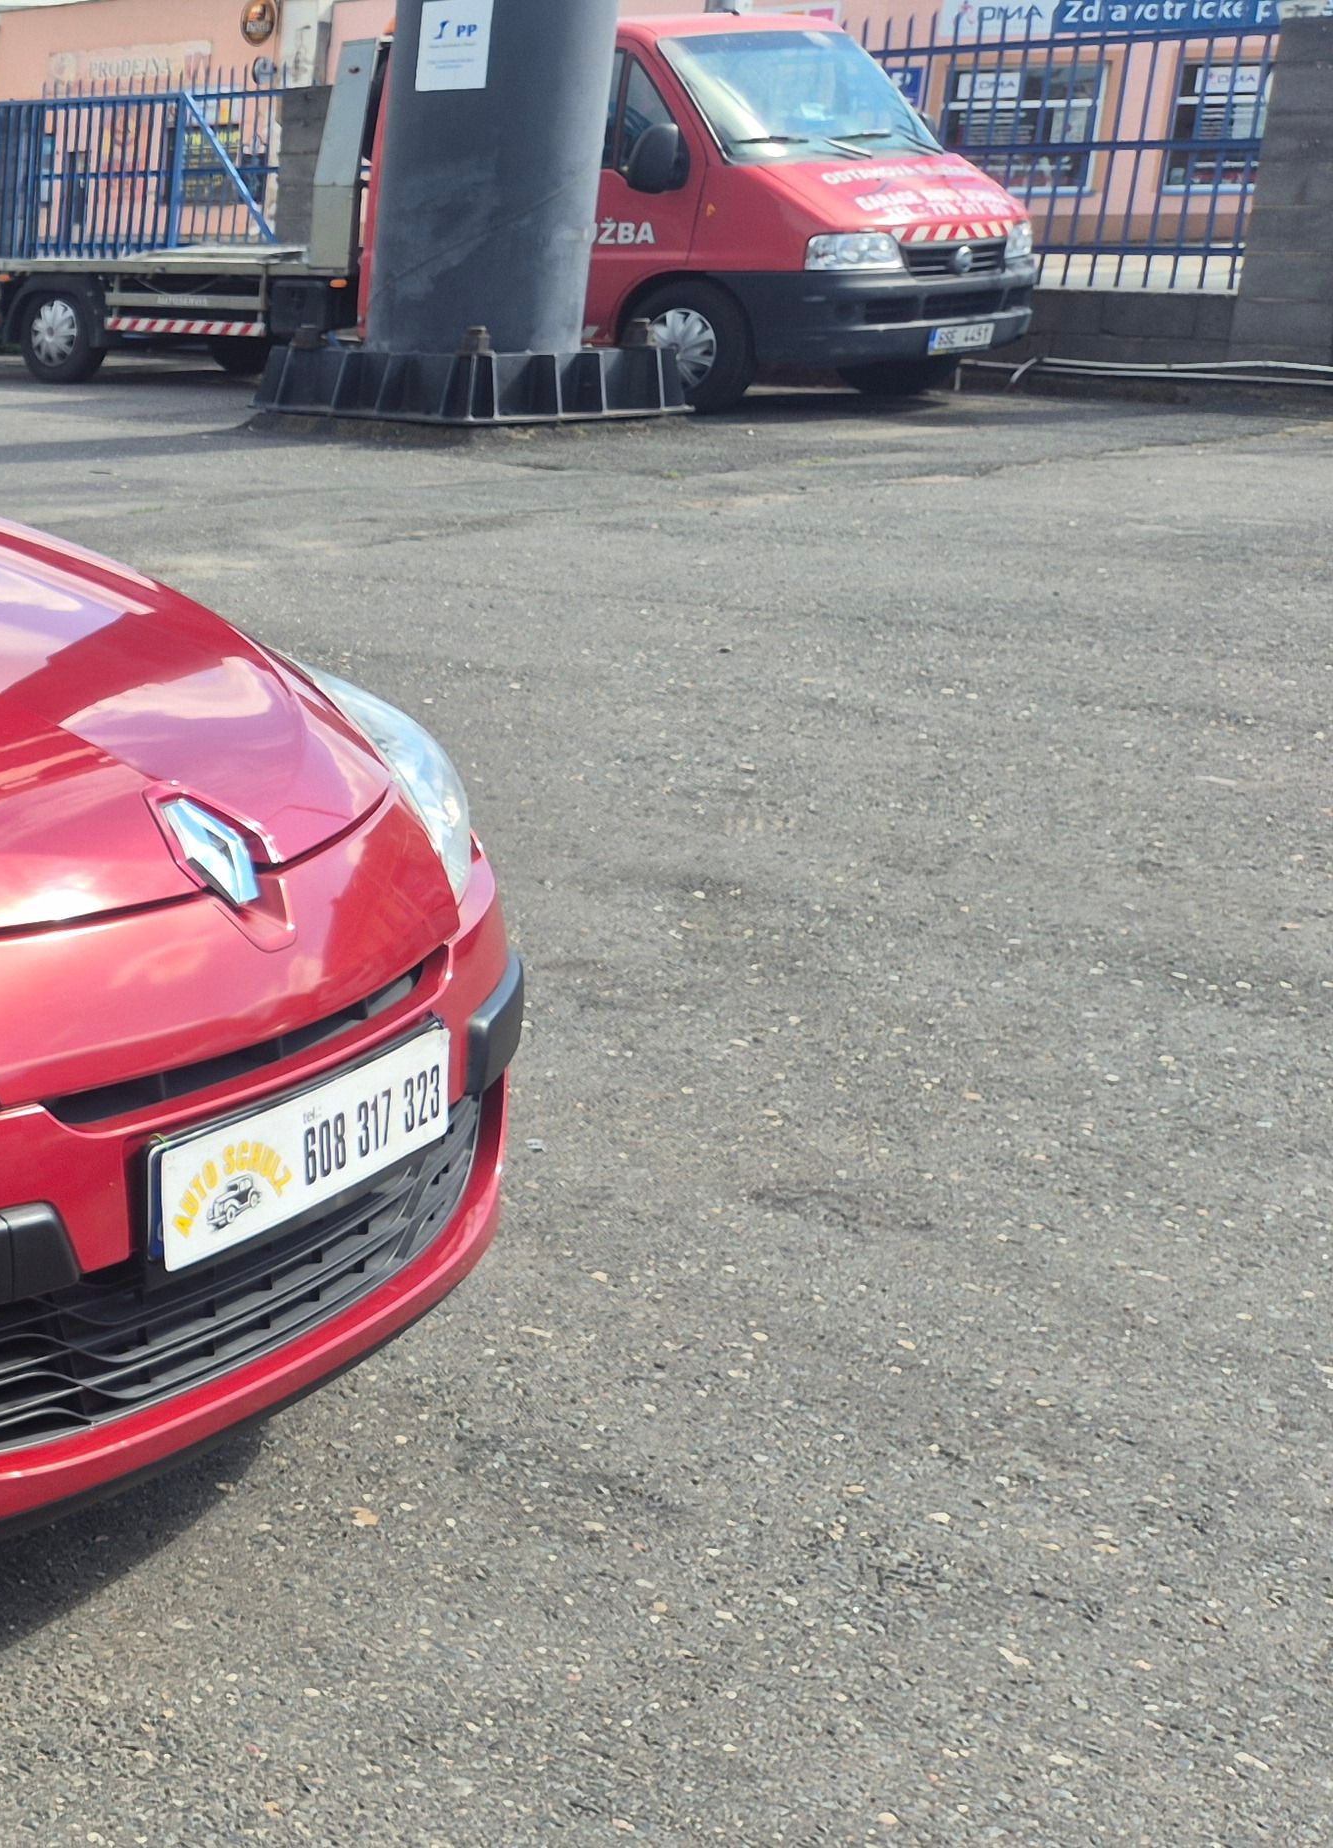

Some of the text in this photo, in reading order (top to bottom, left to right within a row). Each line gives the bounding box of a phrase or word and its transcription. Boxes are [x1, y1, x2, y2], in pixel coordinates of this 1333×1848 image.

[456, 24, 477, 37] PP
[593, 217, 656, 244] ŽBA
[304, 1064, 439, 1185] 608 317 323
[171, 1140, 294, 1238] AUTO SCHULZ
